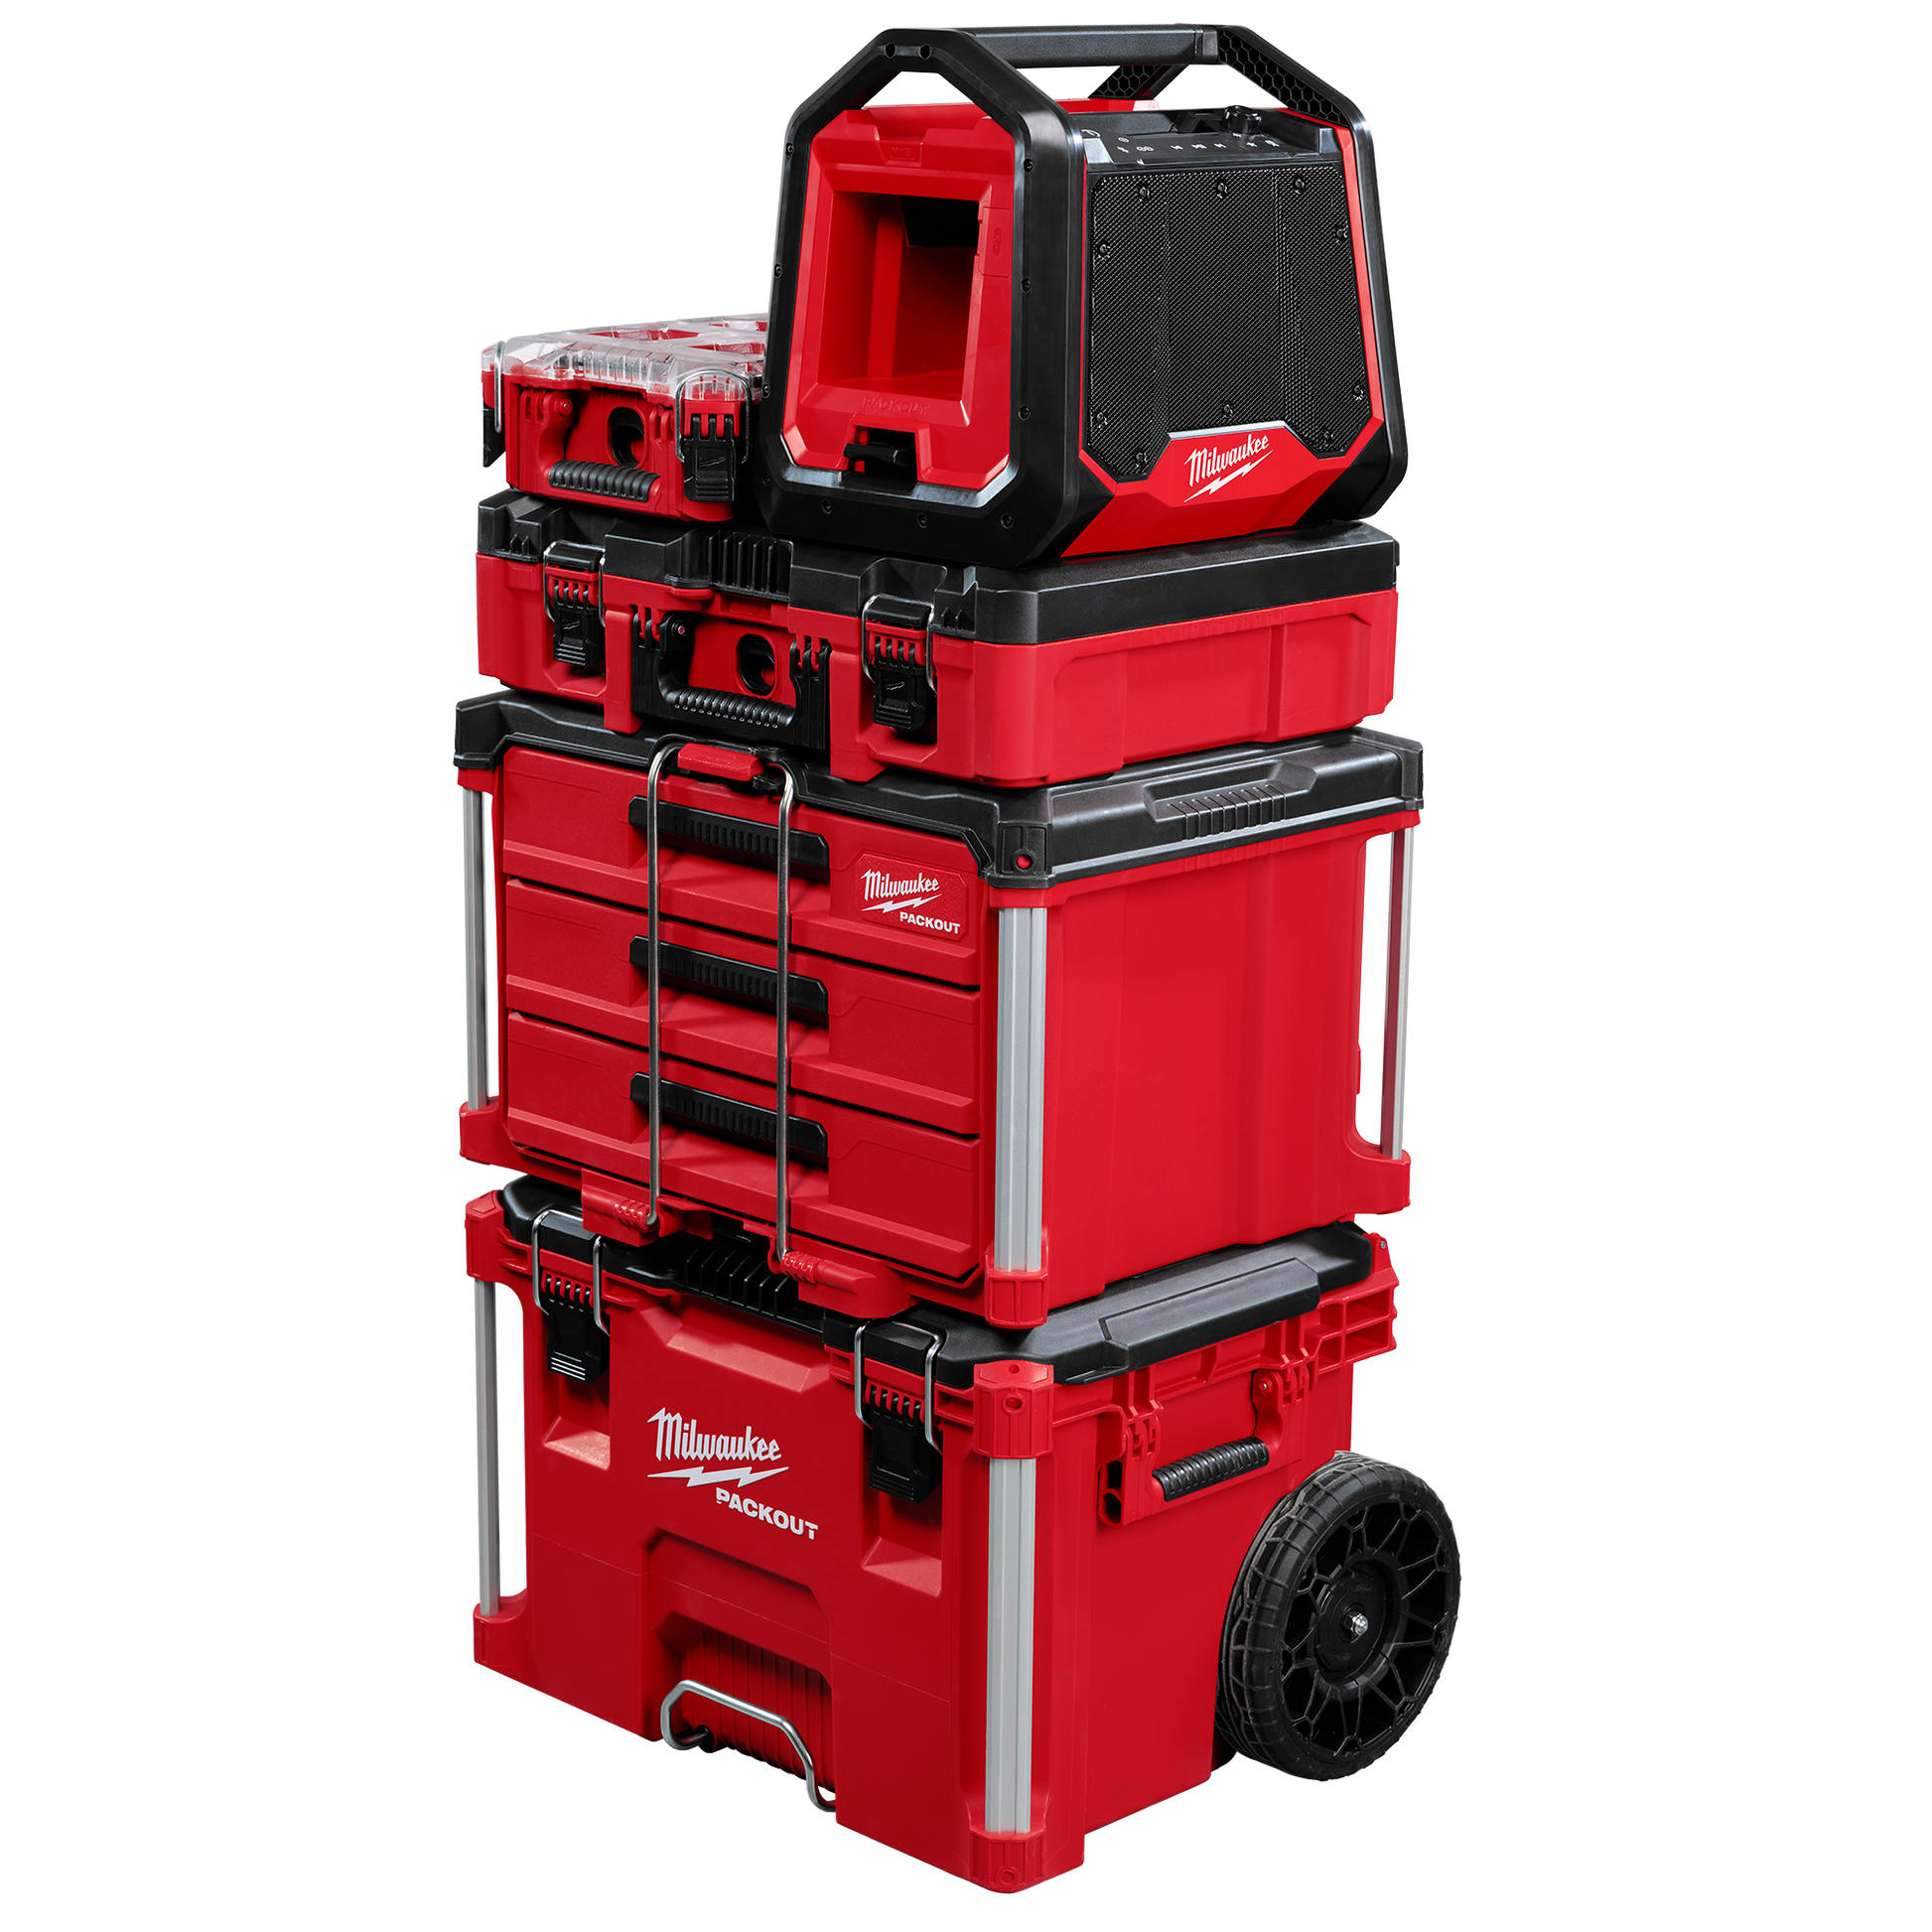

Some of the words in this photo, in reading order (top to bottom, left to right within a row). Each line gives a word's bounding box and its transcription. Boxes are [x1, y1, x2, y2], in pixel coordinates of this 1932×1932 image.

[861, 396, 931, 416] PACKOUT
[1183, 433, 1270, 487] Milwaukee
[860, 869, 940, 901] Milwaukee
[899, 911, 961, 934] PACKOUT
[647, 1407, 782, 1461] Milwaukee
[716, 1486, 819, 1540] PACKOUT
